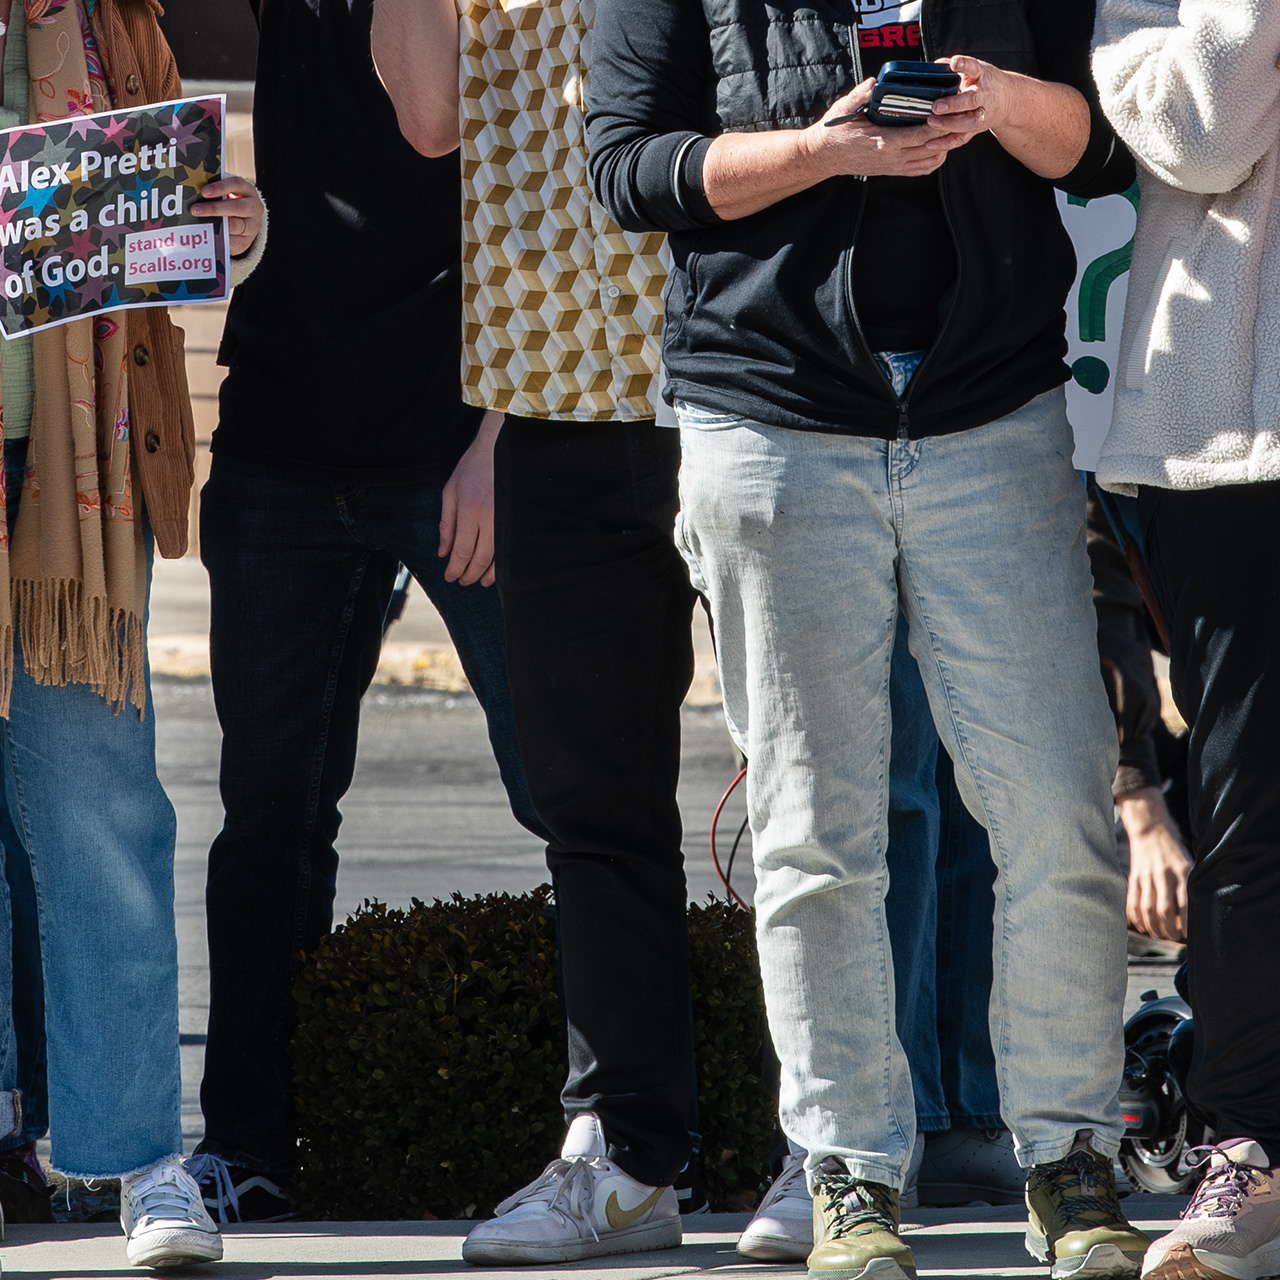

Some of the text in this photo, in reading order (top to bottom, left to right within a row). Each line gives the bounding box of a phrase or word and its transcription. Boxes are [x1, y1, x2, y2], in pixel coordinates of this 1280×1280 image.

[81, 137, 178, 182] Pretti
[69, 208, 89, 233] a
[98, 185, 183, 227] child
[128, 229, 209, 253] stand up!
[4, 244, 120, 299] of God.
[128, 255, 213, 276] 5calls.org
